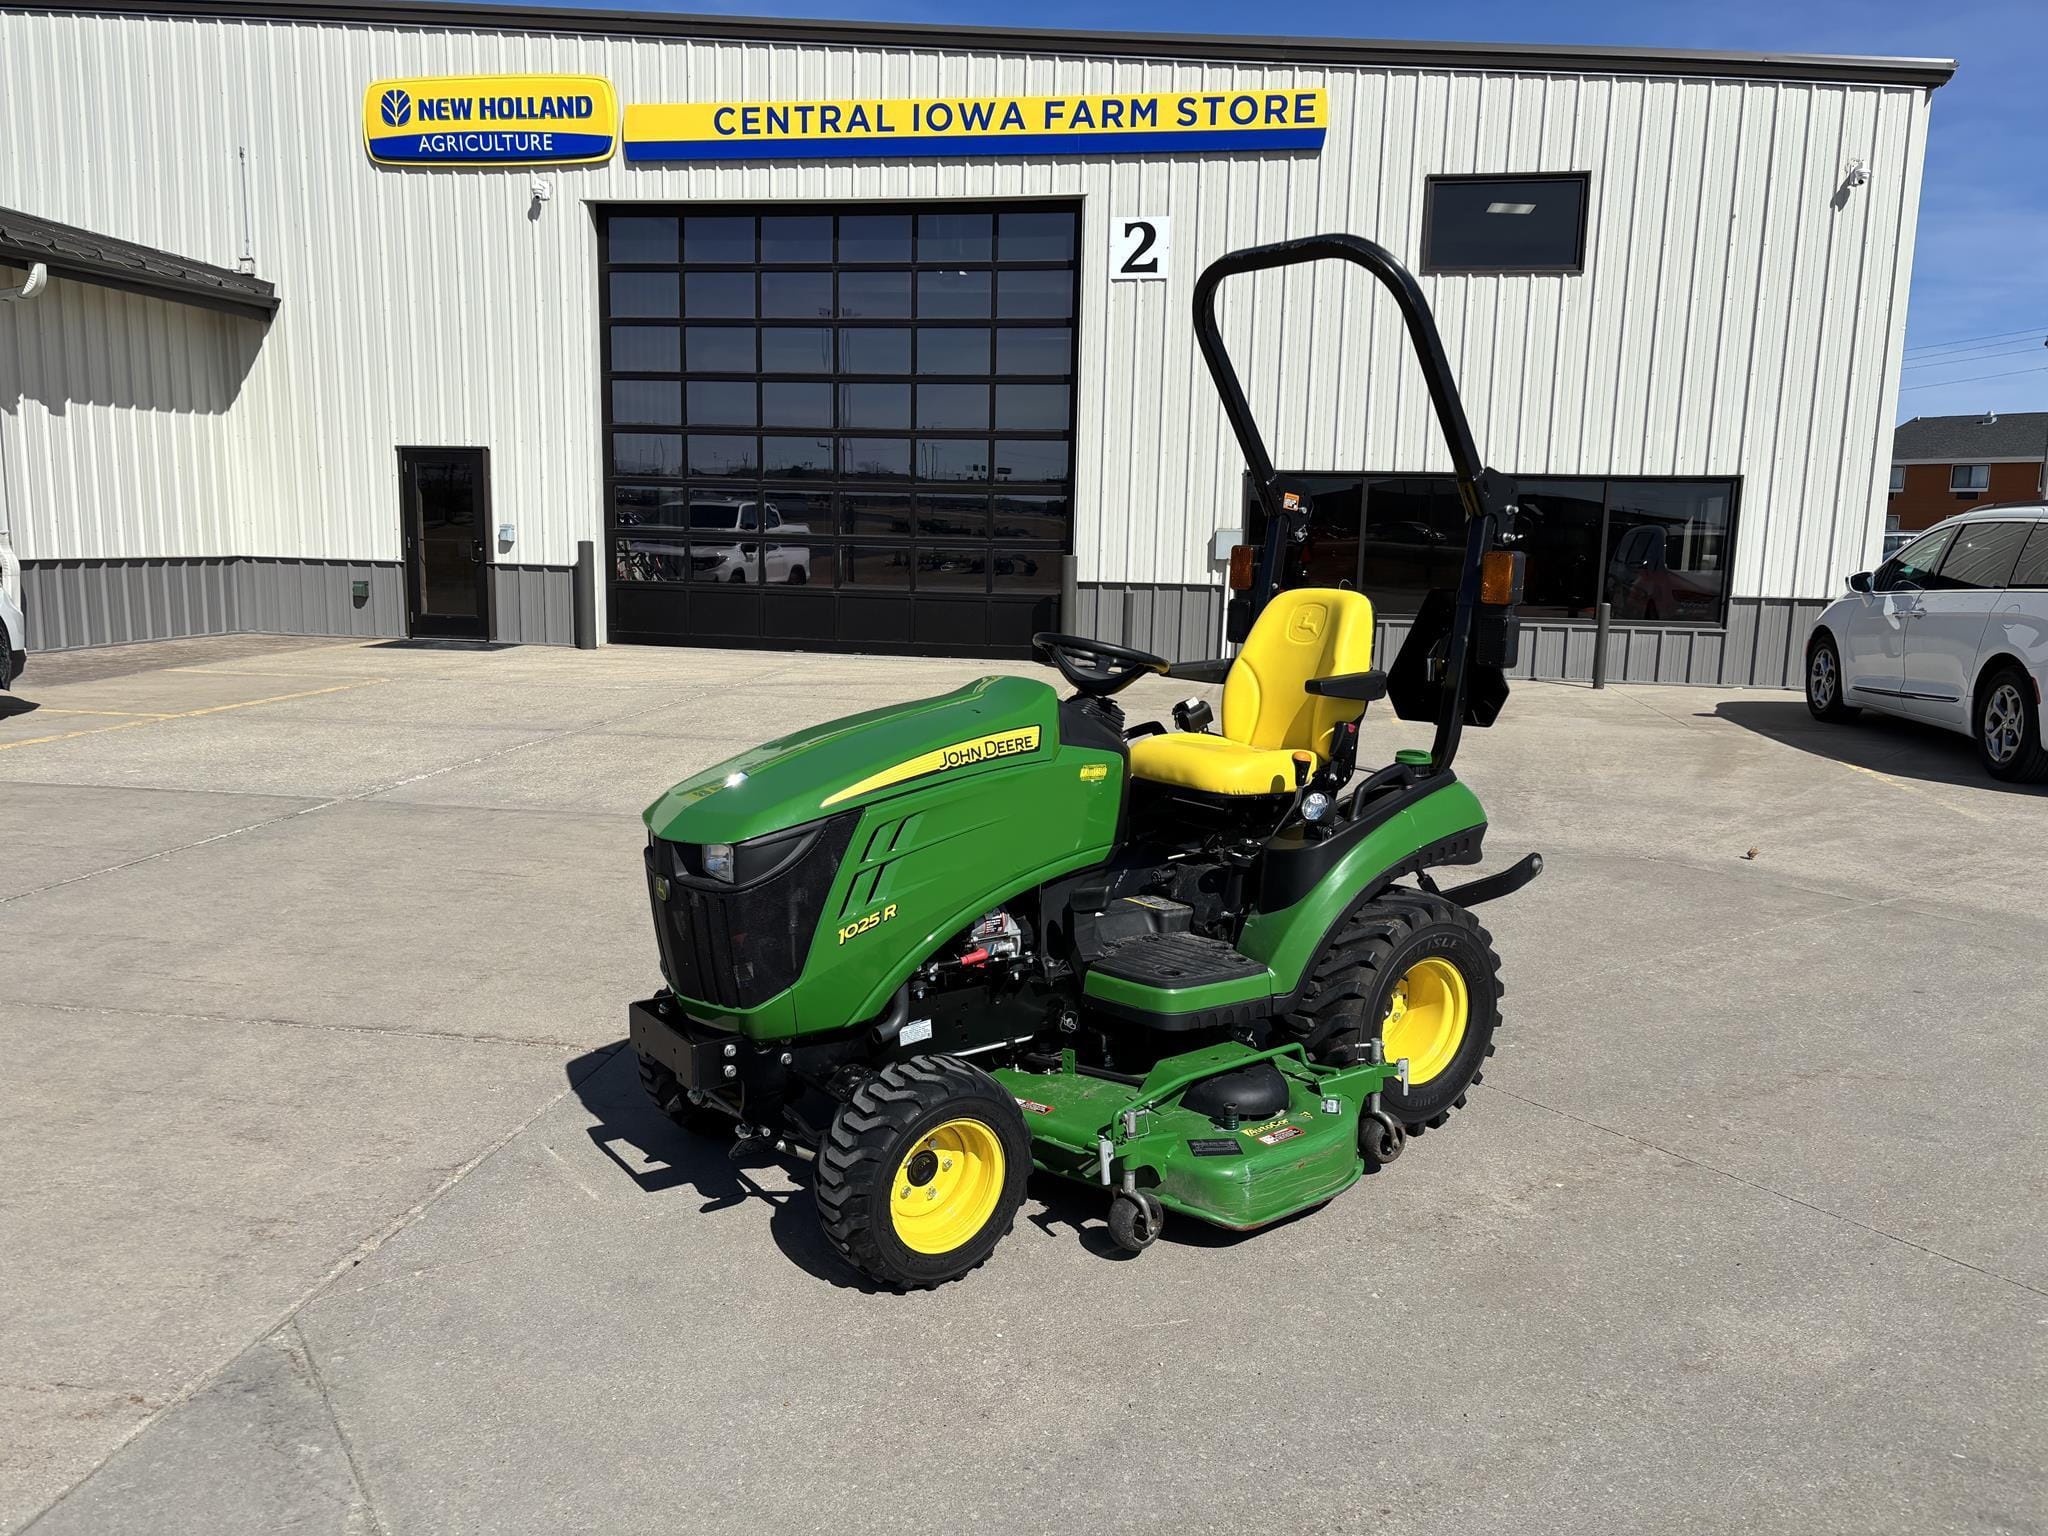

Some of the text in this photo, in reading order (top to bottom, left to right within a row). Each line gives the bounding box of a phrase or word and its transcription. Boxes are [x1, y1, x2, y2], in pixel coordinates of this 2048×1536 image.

[418, 95, 594, 122] NEW HOLLAND
[713, 93, 1317, 136] CENTRAL IOWA FARM STORE
[418, 133, 554, 153] AGRICULTURE
[1120, 221, 1158, 274] 2
[939, 735, 1034, 769] JOHN DEERE
[838, 903, 898, 946] 1025 R
